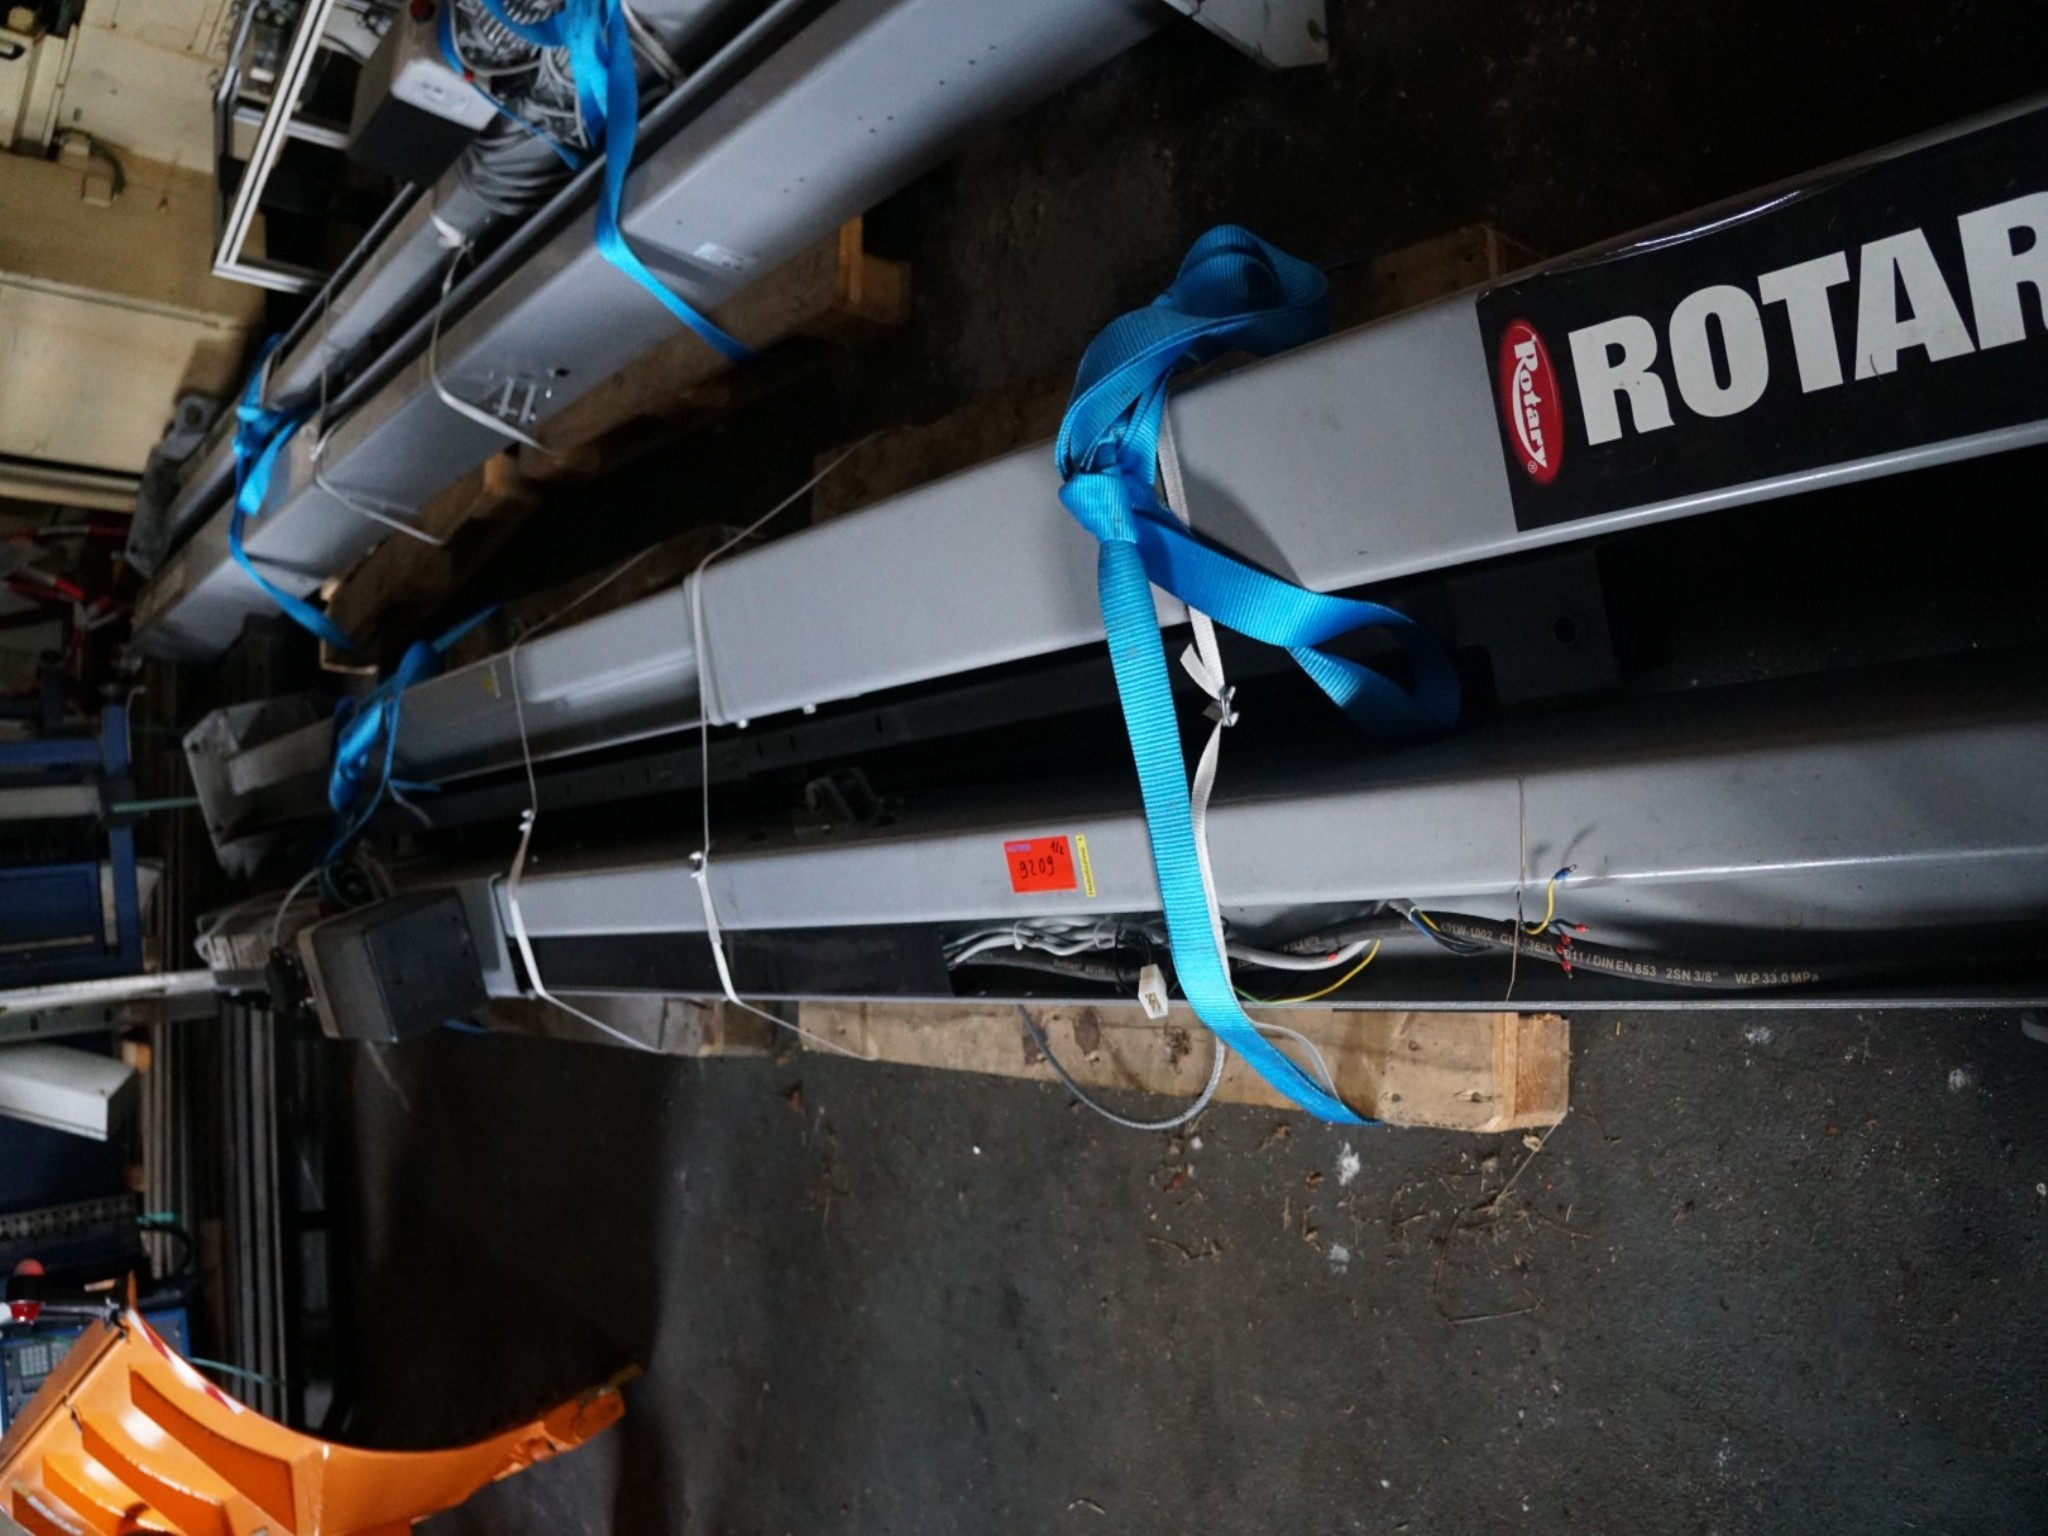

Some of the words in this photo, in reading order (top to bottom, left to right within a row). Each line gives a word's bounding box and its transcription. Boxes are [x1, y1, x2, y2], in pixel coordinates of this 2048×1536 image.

[1512, 340, 1547, 468] Rotary
[1019, 855, 1055, 880] 9209
[1593, 954, 1614, 970] DIN
[1615, 960, 1633, 974] EN
[1635, 963, 1657, 977] 853
[1666, 967, 1691, 981] 2SN
[1790, 971, 1820, 984] MPa
